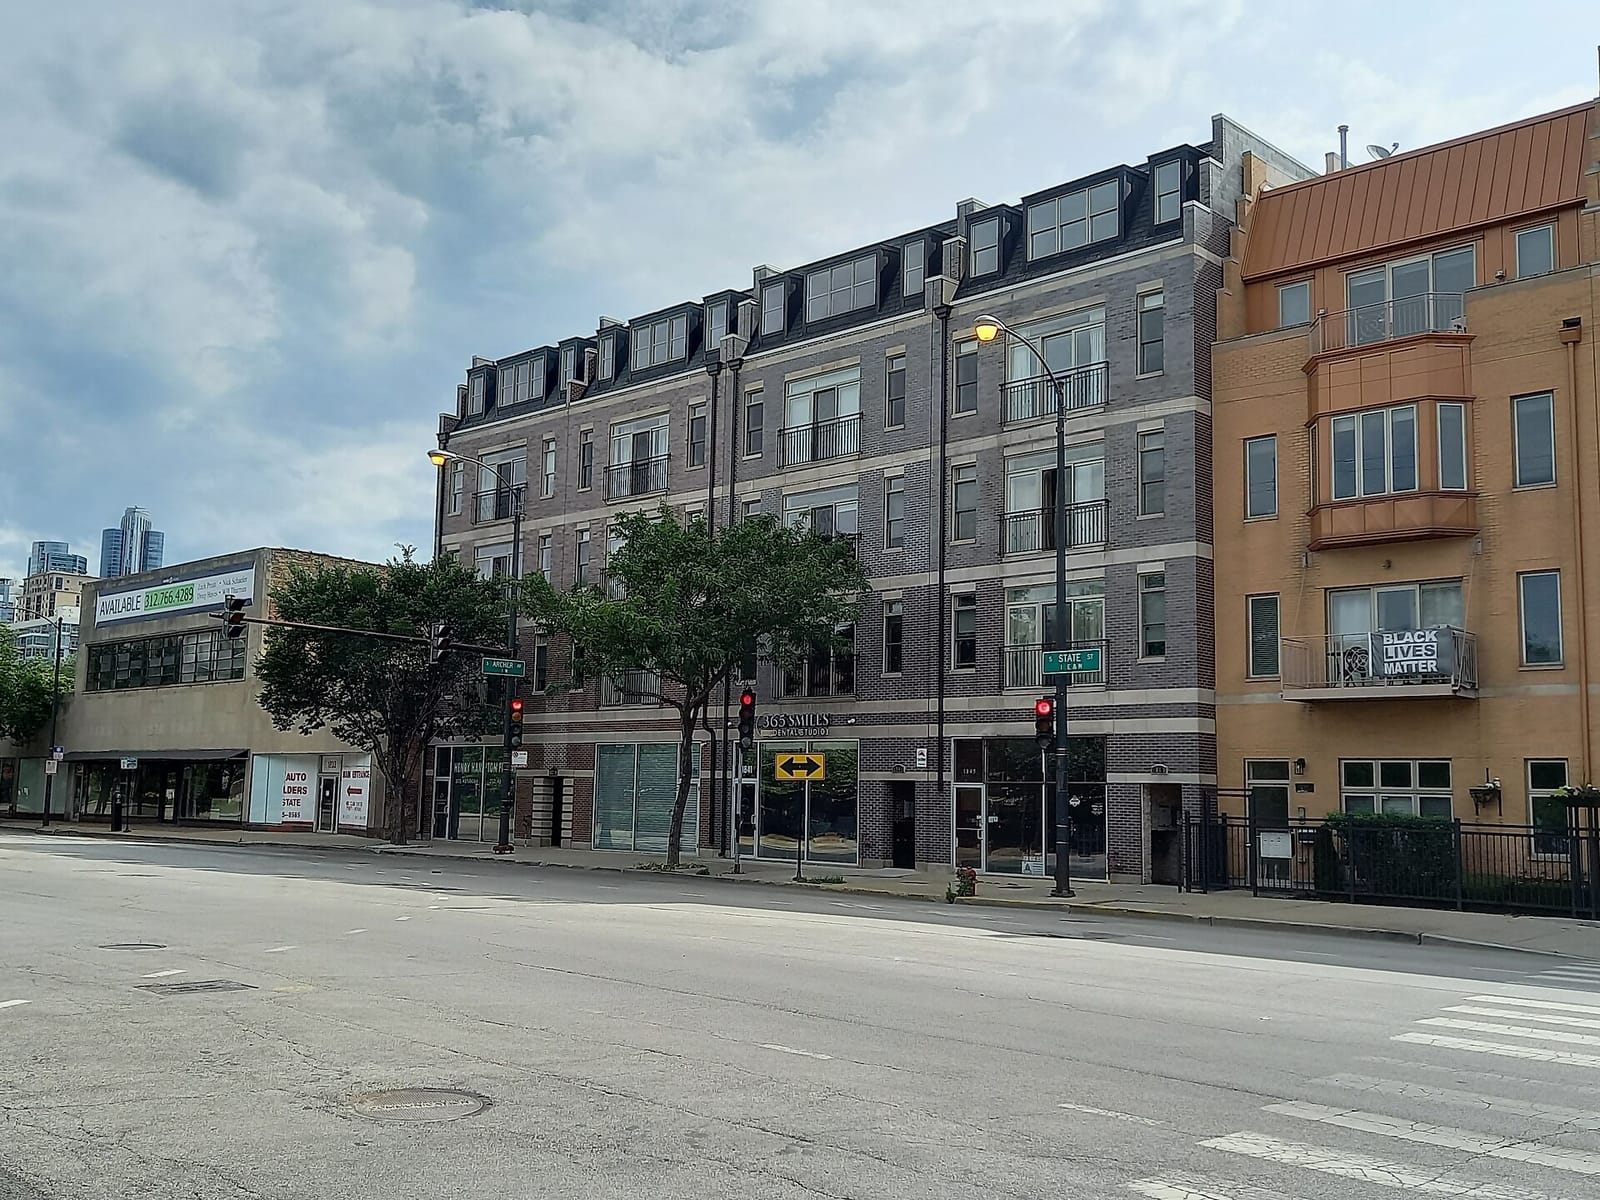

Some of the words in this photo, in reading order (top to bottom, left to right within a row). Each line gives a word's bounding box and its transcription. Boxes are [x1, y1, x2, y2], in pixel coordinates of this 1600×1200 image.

[99, 595, 142, 616] AVAILABLE
[144, 586, 194, 608] 312.766.4289
[1383, 630, 1438, 644] BLACK
[1058, 653, 1082, 662] STATE
[1385, 644, 1436, 660] LIVES
[492, 661, 514, 669] ARCHER
[1384, 660, 1438, 674] MATTER
[762, 714, 786, 728] 365
[788, 713, 829, 727] SMILES
[774, 728, 798, 737] DENTAL
[454, 762, 471, 773] HENRY
[285, 772, 307, 782] AUTO
[282, 798, 301, 807] STATE
